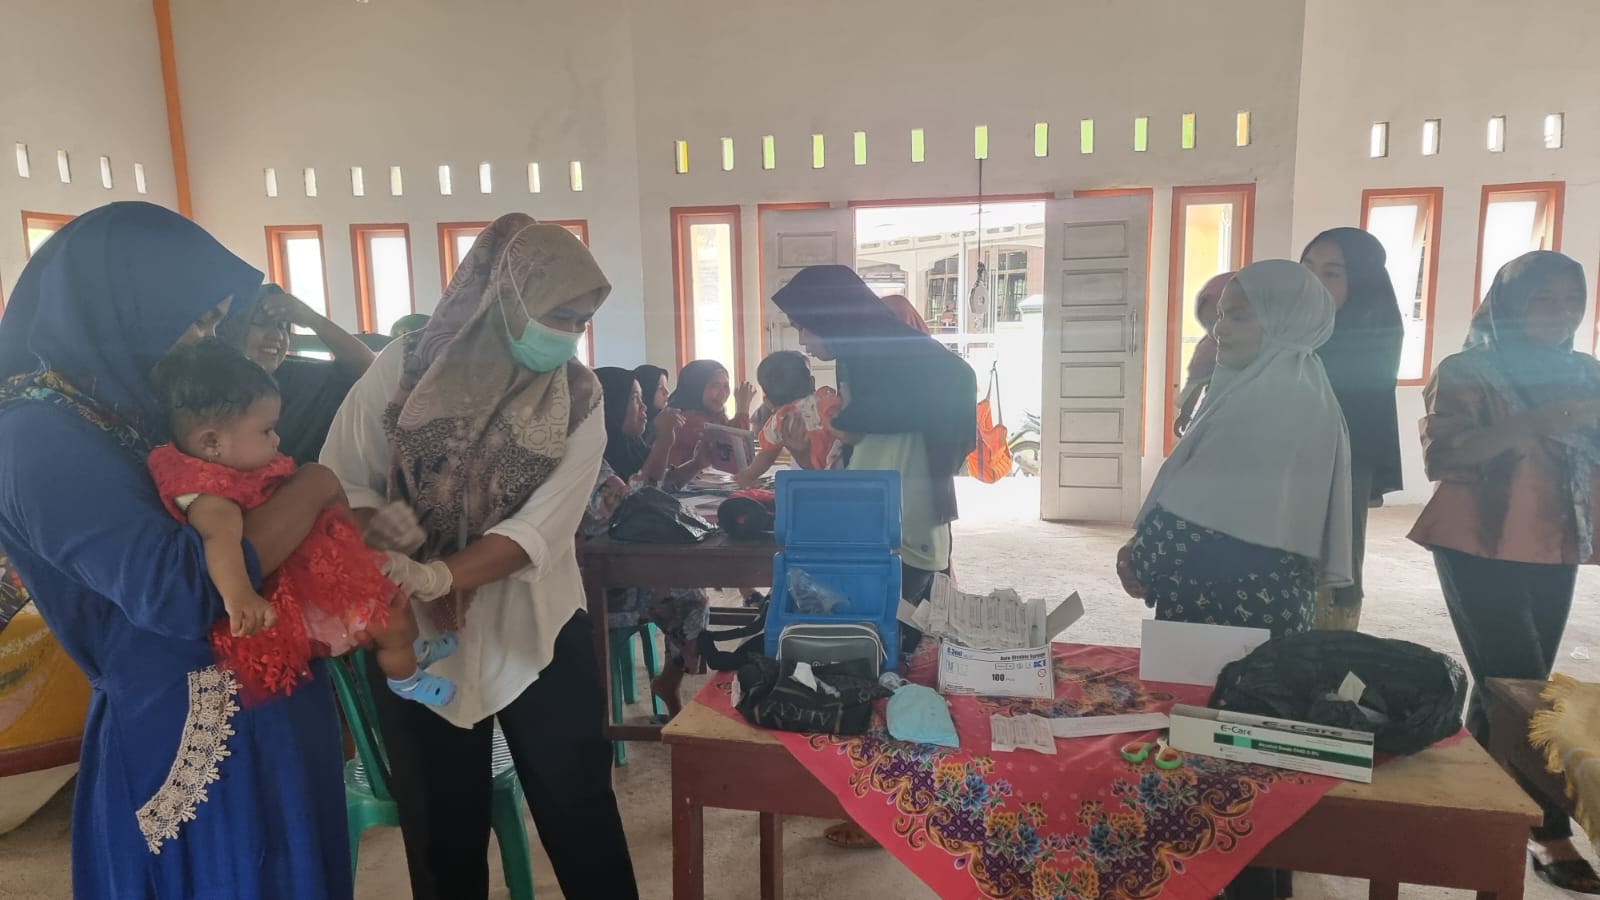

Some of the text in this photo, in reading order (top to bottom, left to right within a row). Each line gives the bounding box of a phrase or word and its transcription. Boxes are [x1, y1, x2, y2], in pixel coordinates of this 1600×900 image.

[992, 673, 1005, 682] 100
[1221, 725, 1252, 735] E-Care
[1262, 721, 1342, 735] E-Care
